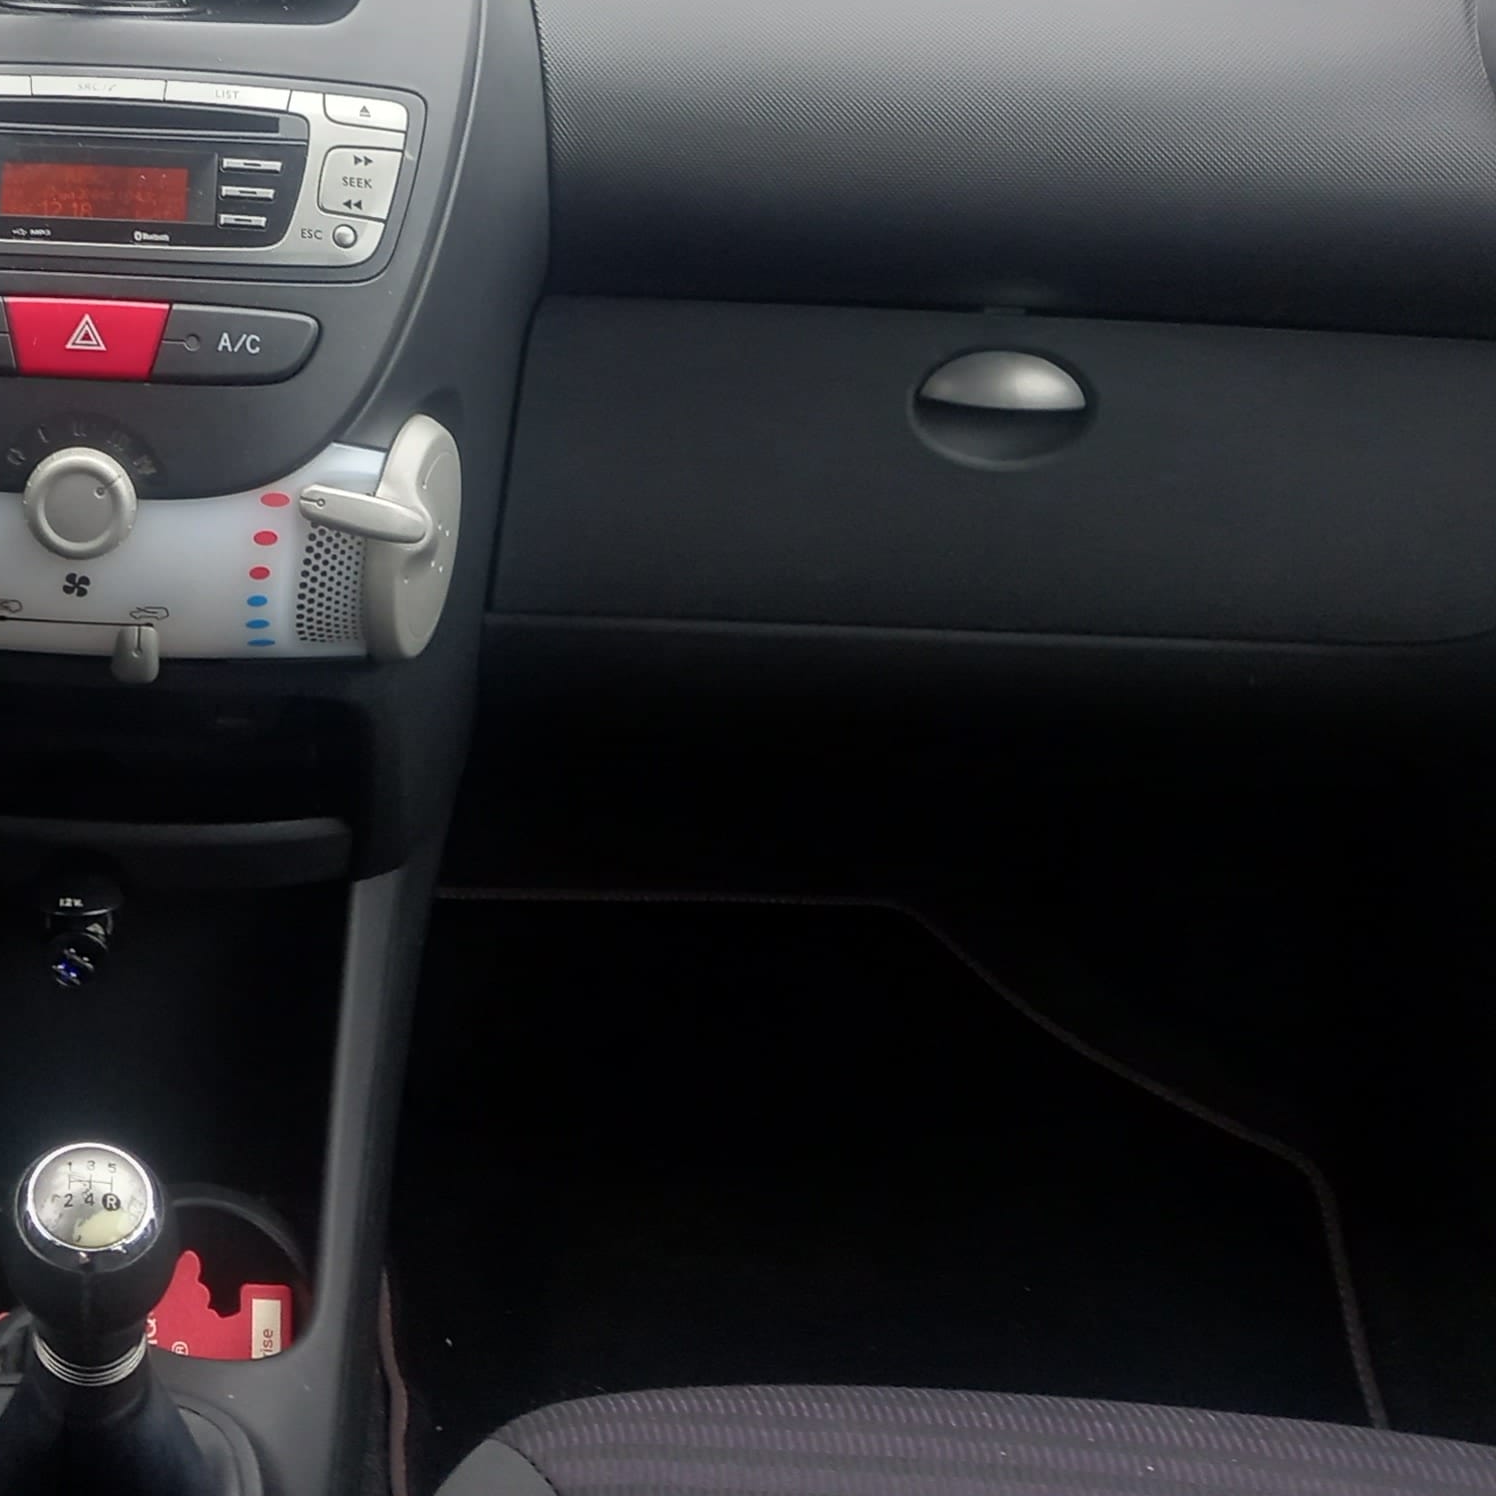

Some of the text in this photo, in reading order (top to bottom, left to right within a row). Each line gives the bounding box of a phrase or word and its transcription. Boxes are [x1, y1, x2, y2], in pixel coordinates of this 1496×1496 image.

[215, 89, 241, 100] LIST
[342, 176, 373, 189] SEEK
[300, 228, 323, 240] ESC
[217, 332, 261, 355] A/C
[66, 1160, 117, 1174] 1 3 5
[64, 1193, 73, 1208] 2
[84, 1193, 95, 1207] 4
[259, 1328, 274, 1356] ise
